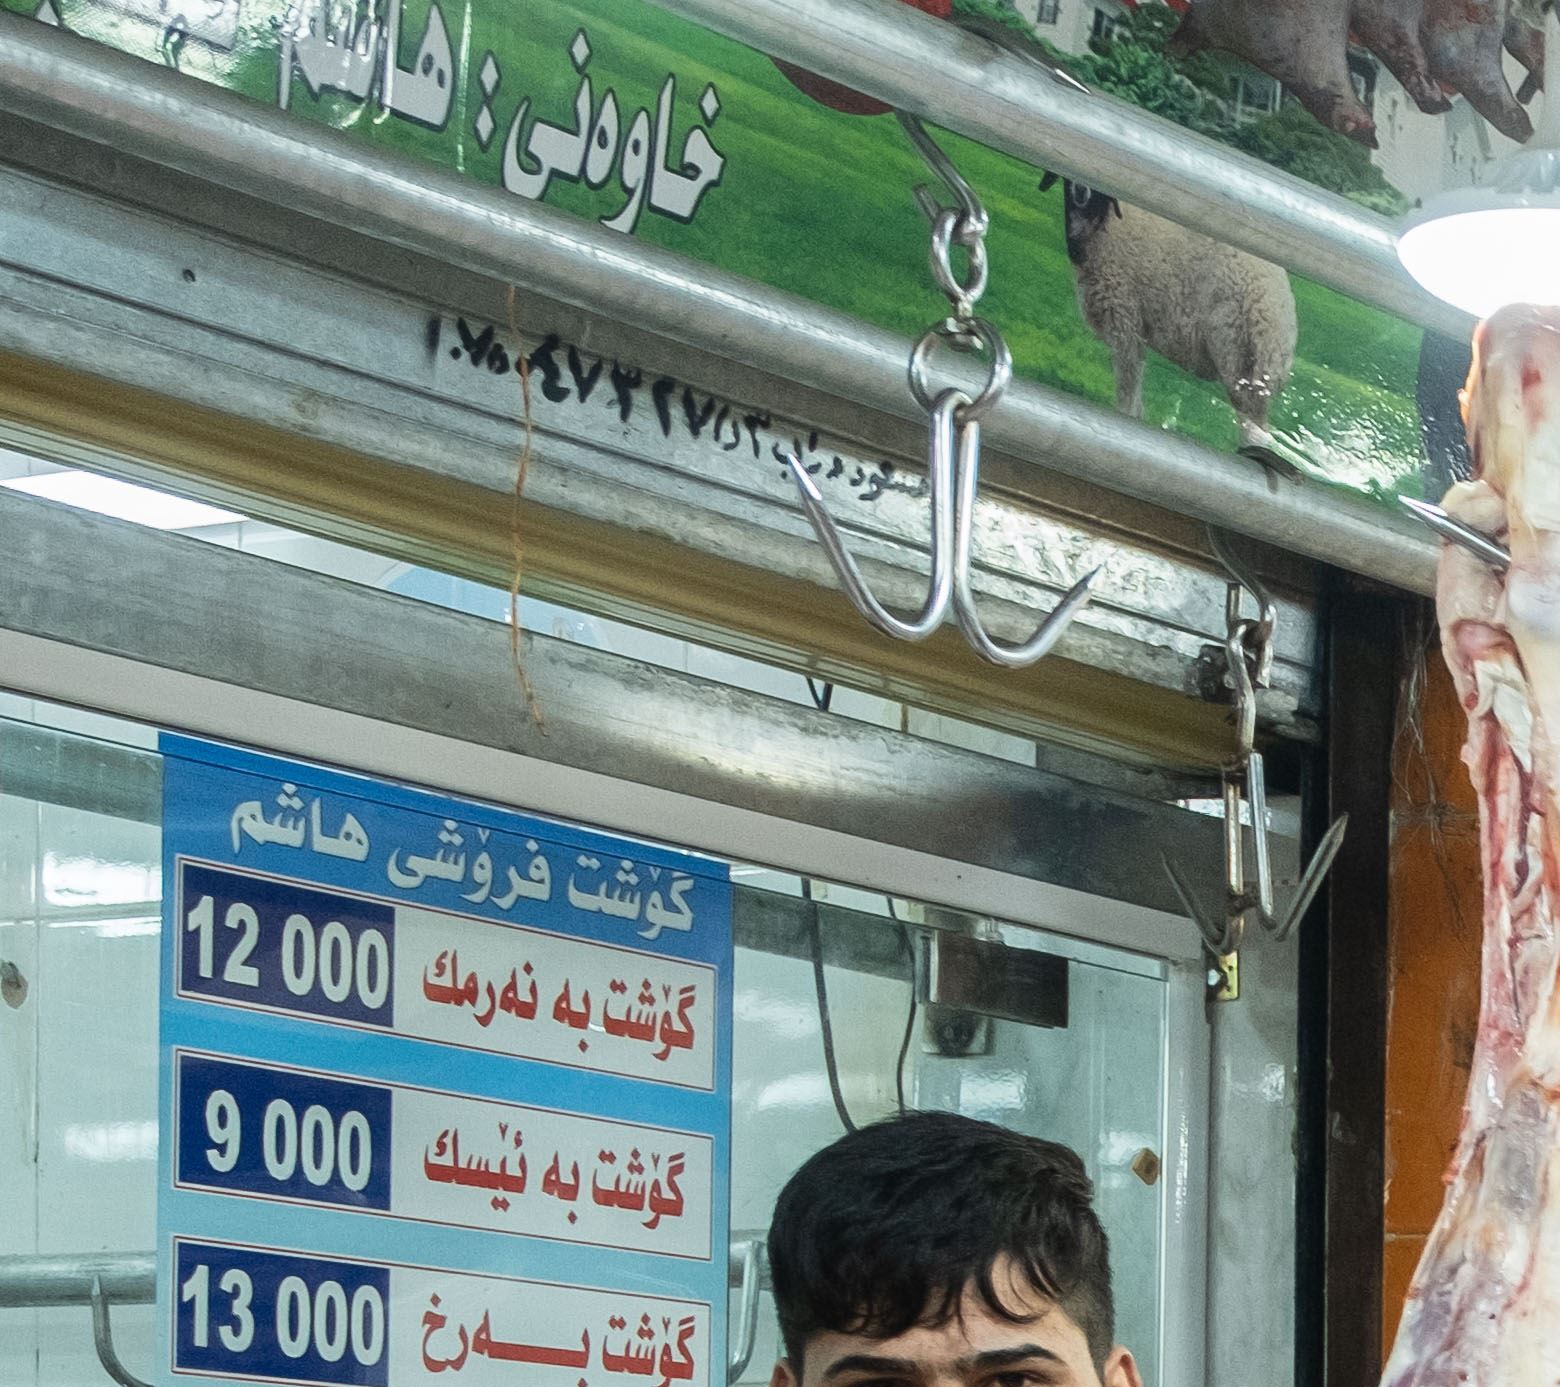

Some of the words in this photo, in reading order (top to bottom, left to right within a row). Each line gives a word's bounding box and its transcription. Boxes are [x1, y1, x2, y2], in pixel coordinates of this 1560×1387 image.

[231, 784, 369, 862] هاشم
[388, 820, 551, 910] فرۆشی
[568, 854, 694, 939] گۆشت
[186, 895, 259, 987] 12
[281, 913, 389, 1010] 000
[603, 979, 696, 1060] گۆشت
[205, 1090, 239, 1173] 9
[264, 1095, 371, 1192] 000
[592, 1148, 686, 1229] گۆشت
[181, 1265, 255, 1353] 13
[276, 1274, 385, 1367] 000
